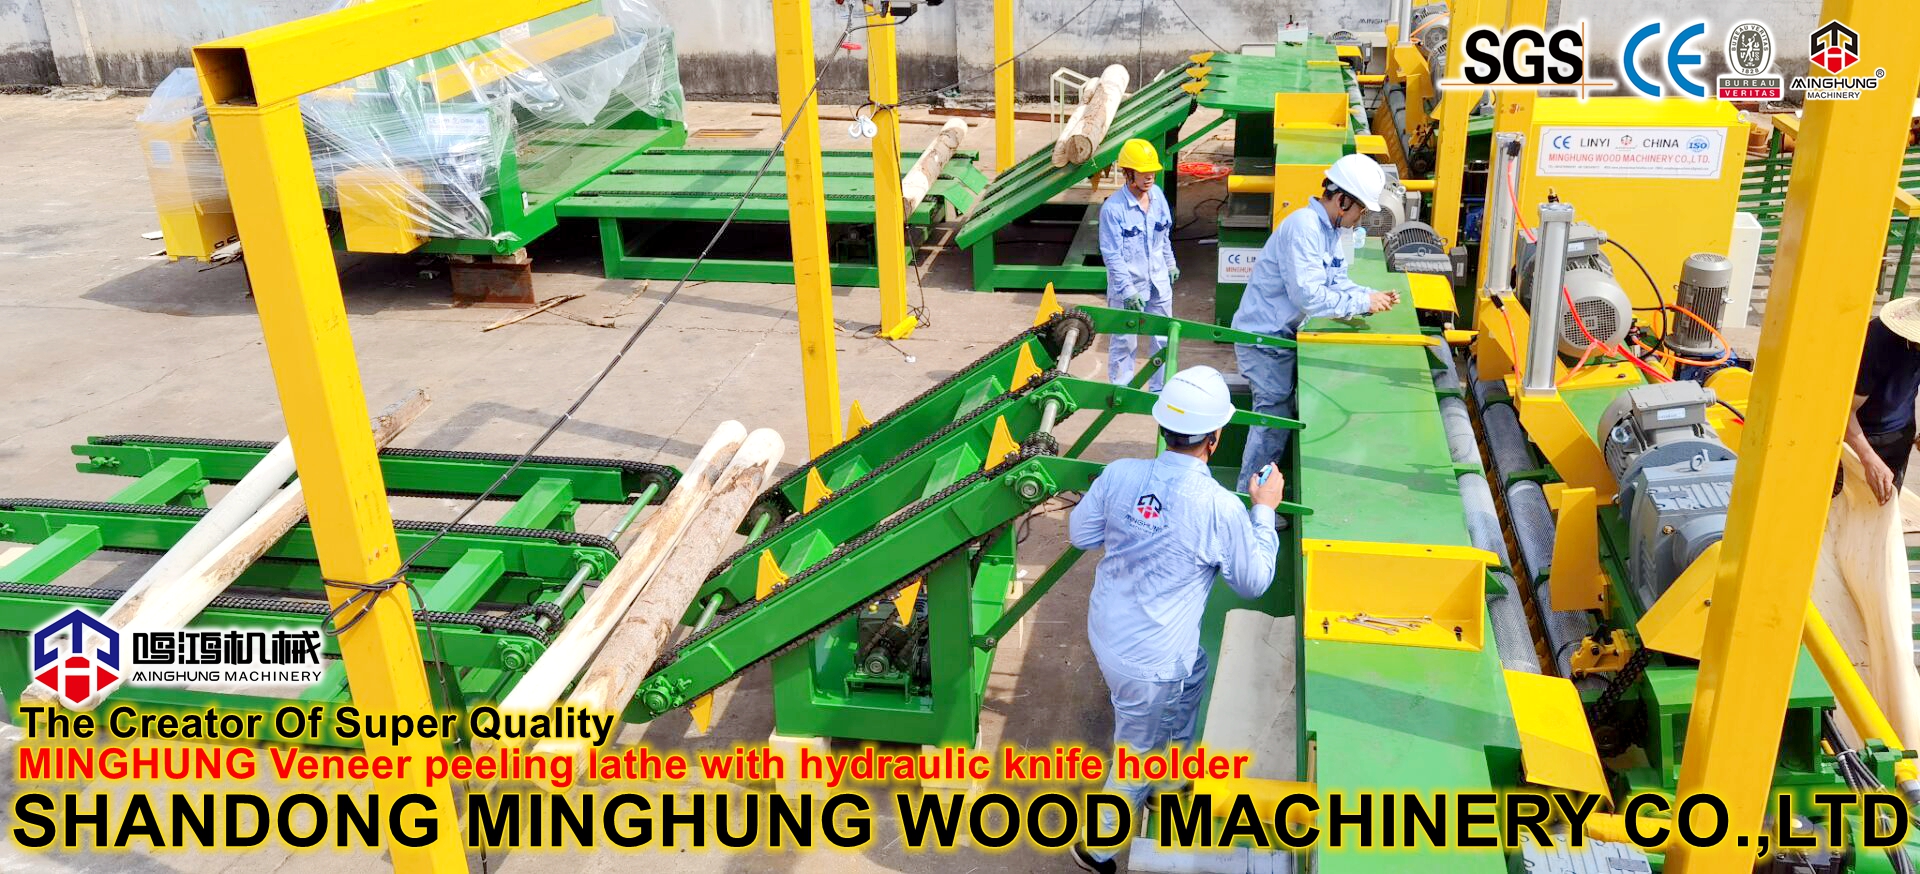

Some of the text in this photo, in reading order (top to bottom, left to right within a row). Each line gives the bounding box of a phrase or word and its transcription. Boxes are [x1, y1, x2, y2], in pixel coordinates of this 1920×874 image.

[1553, 135, 1572, 150] CE
[1580, 138, 1611, 148] LINYI
[1642, 138, 1680, 149] CHINA
[1688, 142, 1708, 150] ISO
[1548, 153, 1594, 162] MINGHUNG
[1595, 153, 1621, 163] WOOD
[1622, 153, 1674, 164] MACHINERY
[1228, 254, 1241, 264] CE
